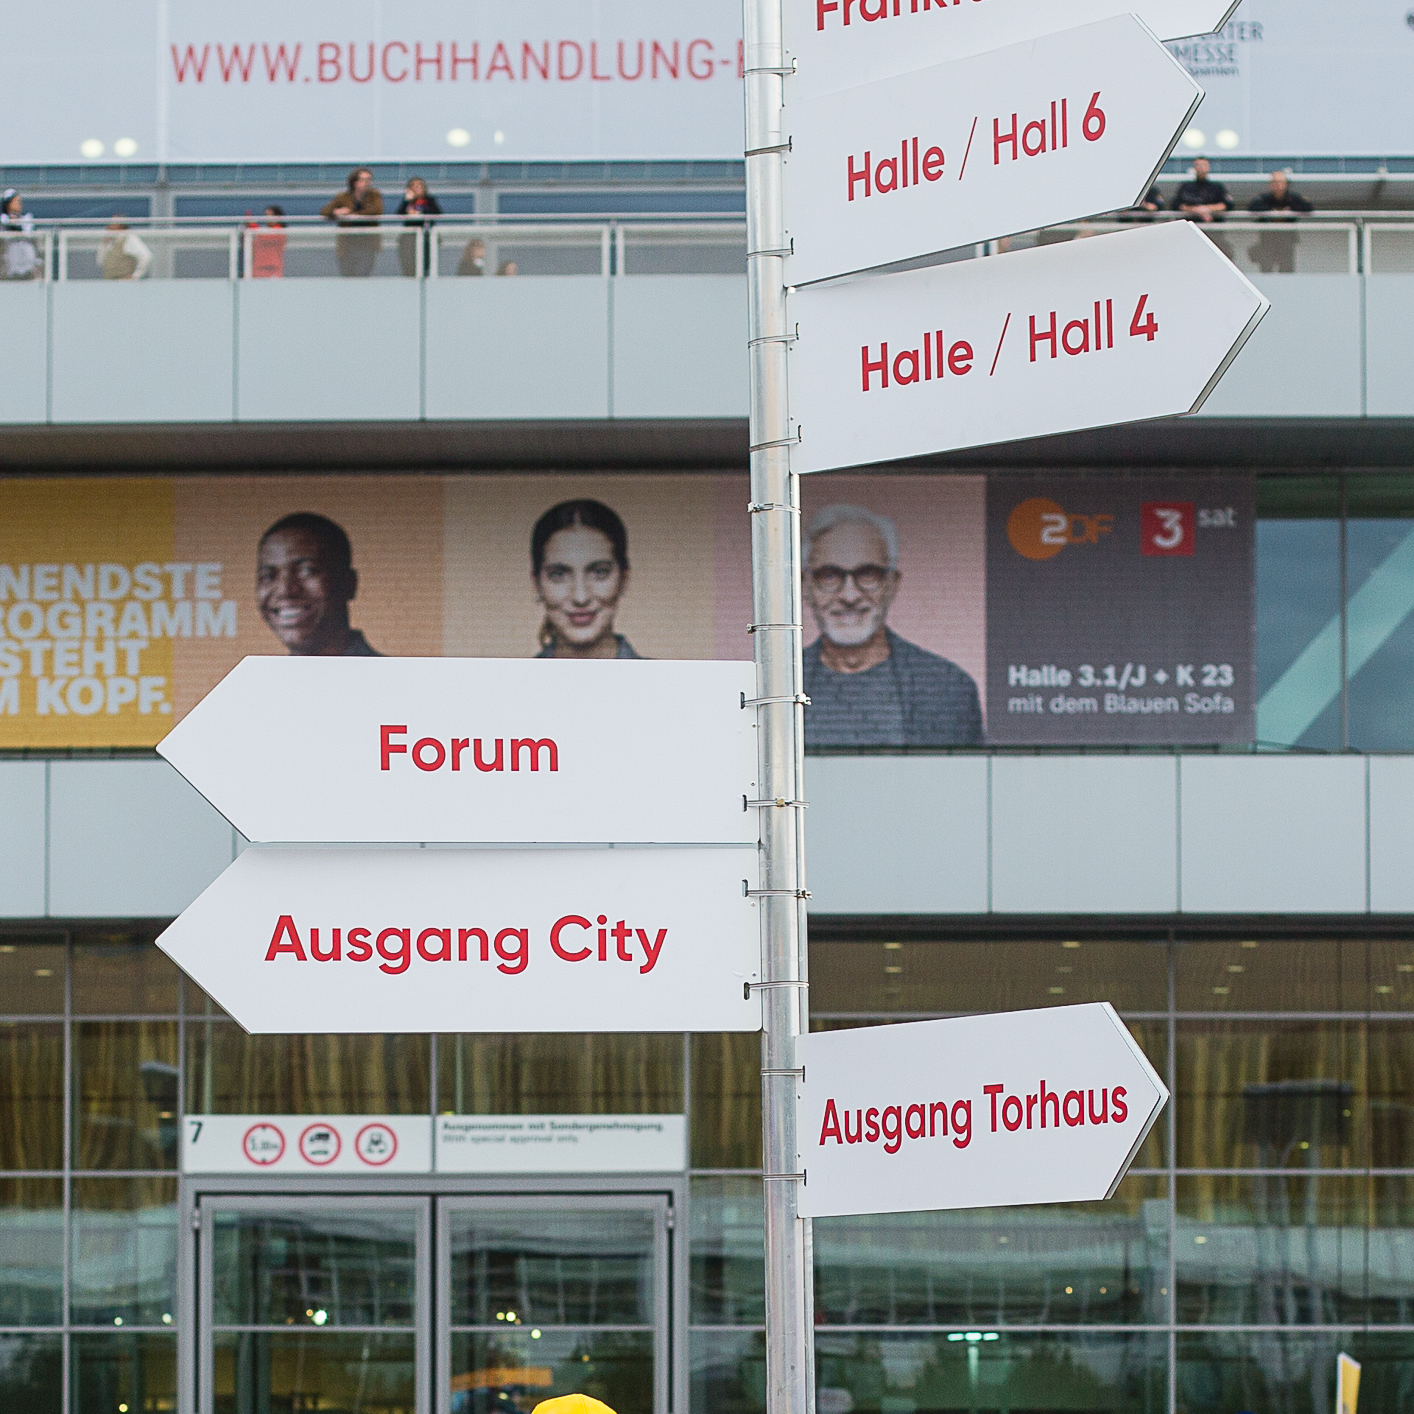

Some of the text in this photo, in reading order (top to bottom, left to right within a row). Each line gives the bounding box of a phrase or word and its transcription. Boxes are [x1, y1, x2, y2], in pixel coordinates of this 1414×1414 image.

[170, 39, 744, 84] WWW.BUCHHANDLUNG-
[847, 91, 1107, 202] Halle / Hall 6
[861, 293, 1159, 392] Halle / Hall 4
[36, 676, 172, 715] KOPF.
[1008, 664, 1071, 687] Halle
[1079, 664, 1147, 692] 3.1/J
[1176, 665, 1196, 687] K
[1202, 664, 1235, 688] 23
[1008, 693, 1235, 714] mit dem Blauen Sofa
[380, 725, 559, 773] Forum
[265, 915, 668, 976] Ausgang City
[188, 1121, 203, 1144] 7
[820, 1080, 1129, 1155] Ausgang Torhaus
